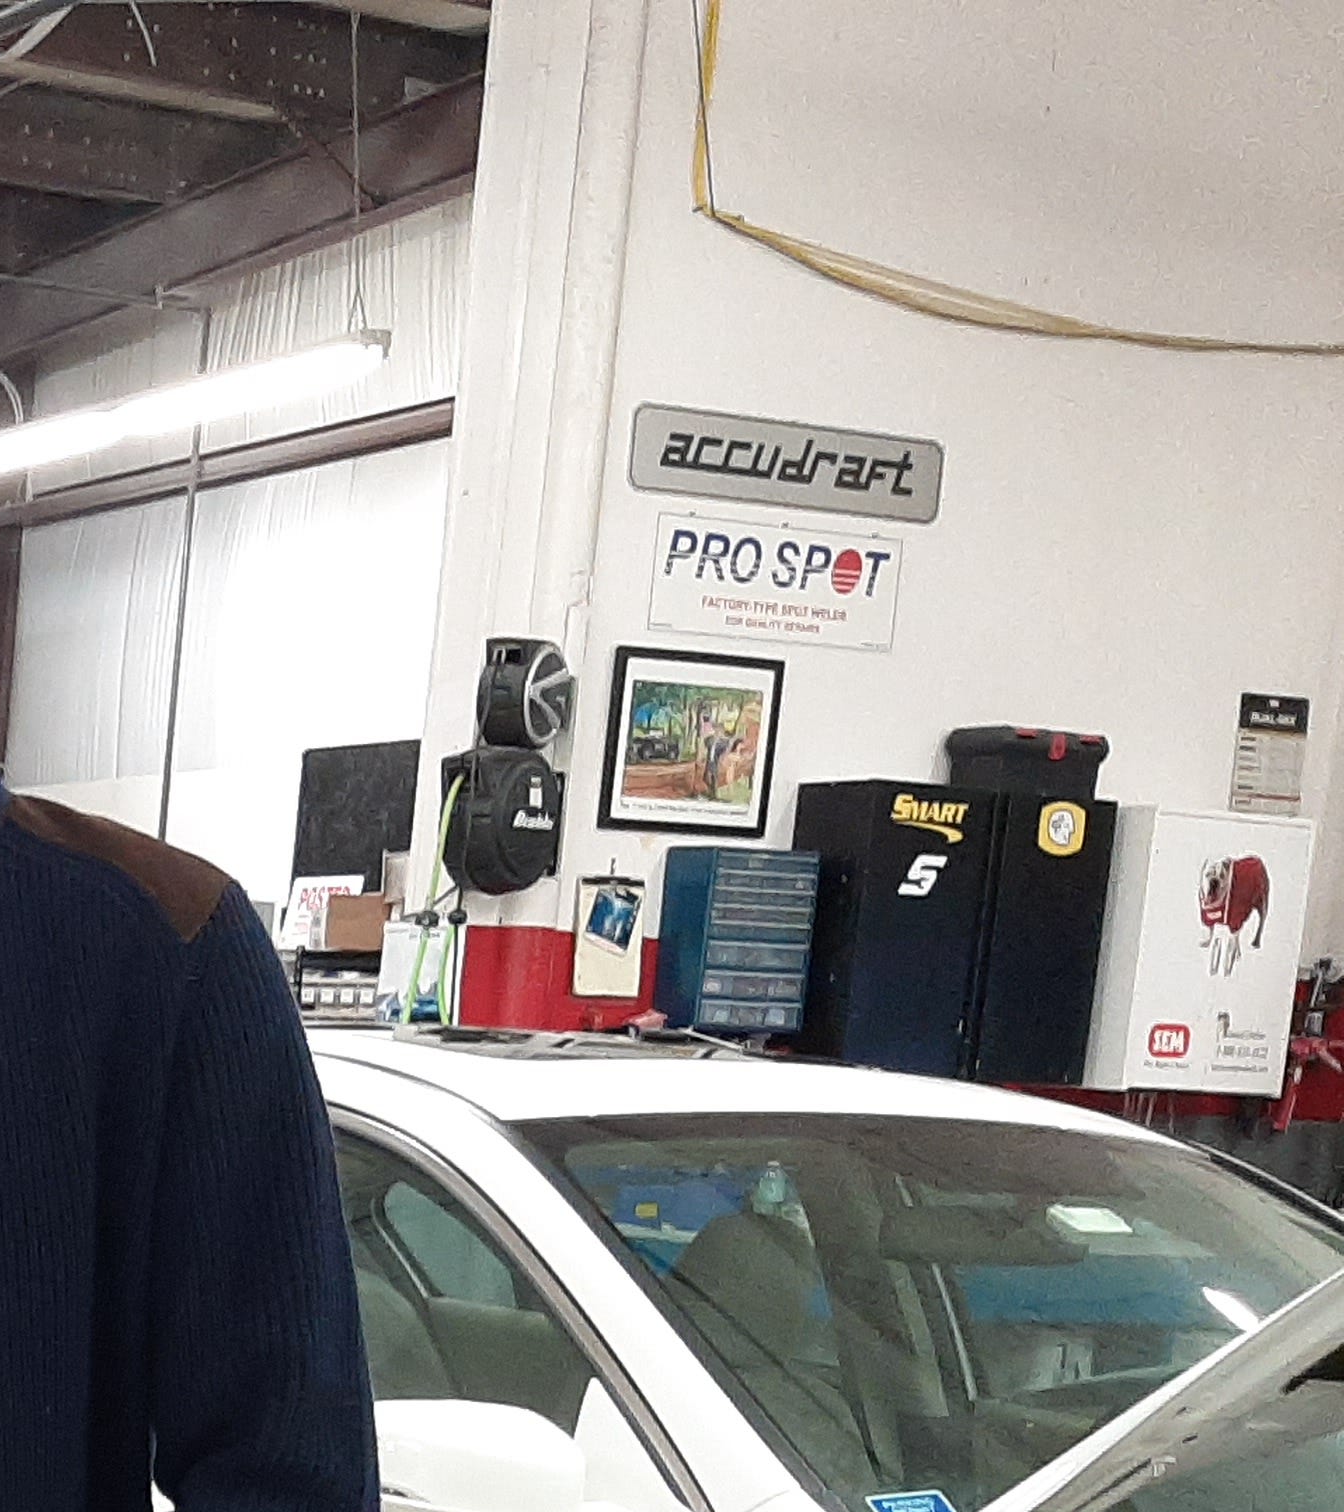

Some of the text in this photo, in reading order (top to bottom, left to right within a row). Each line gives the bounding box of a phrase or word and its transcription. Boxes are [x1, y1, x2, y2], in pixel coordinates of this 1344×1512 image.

[660, 433, 914, 497] accudraft
[664, 529, 892, 597] PRO SPOT
[890, 793, 970, 825] SMART
[1152, 1030, 1185, 1053] SEM
